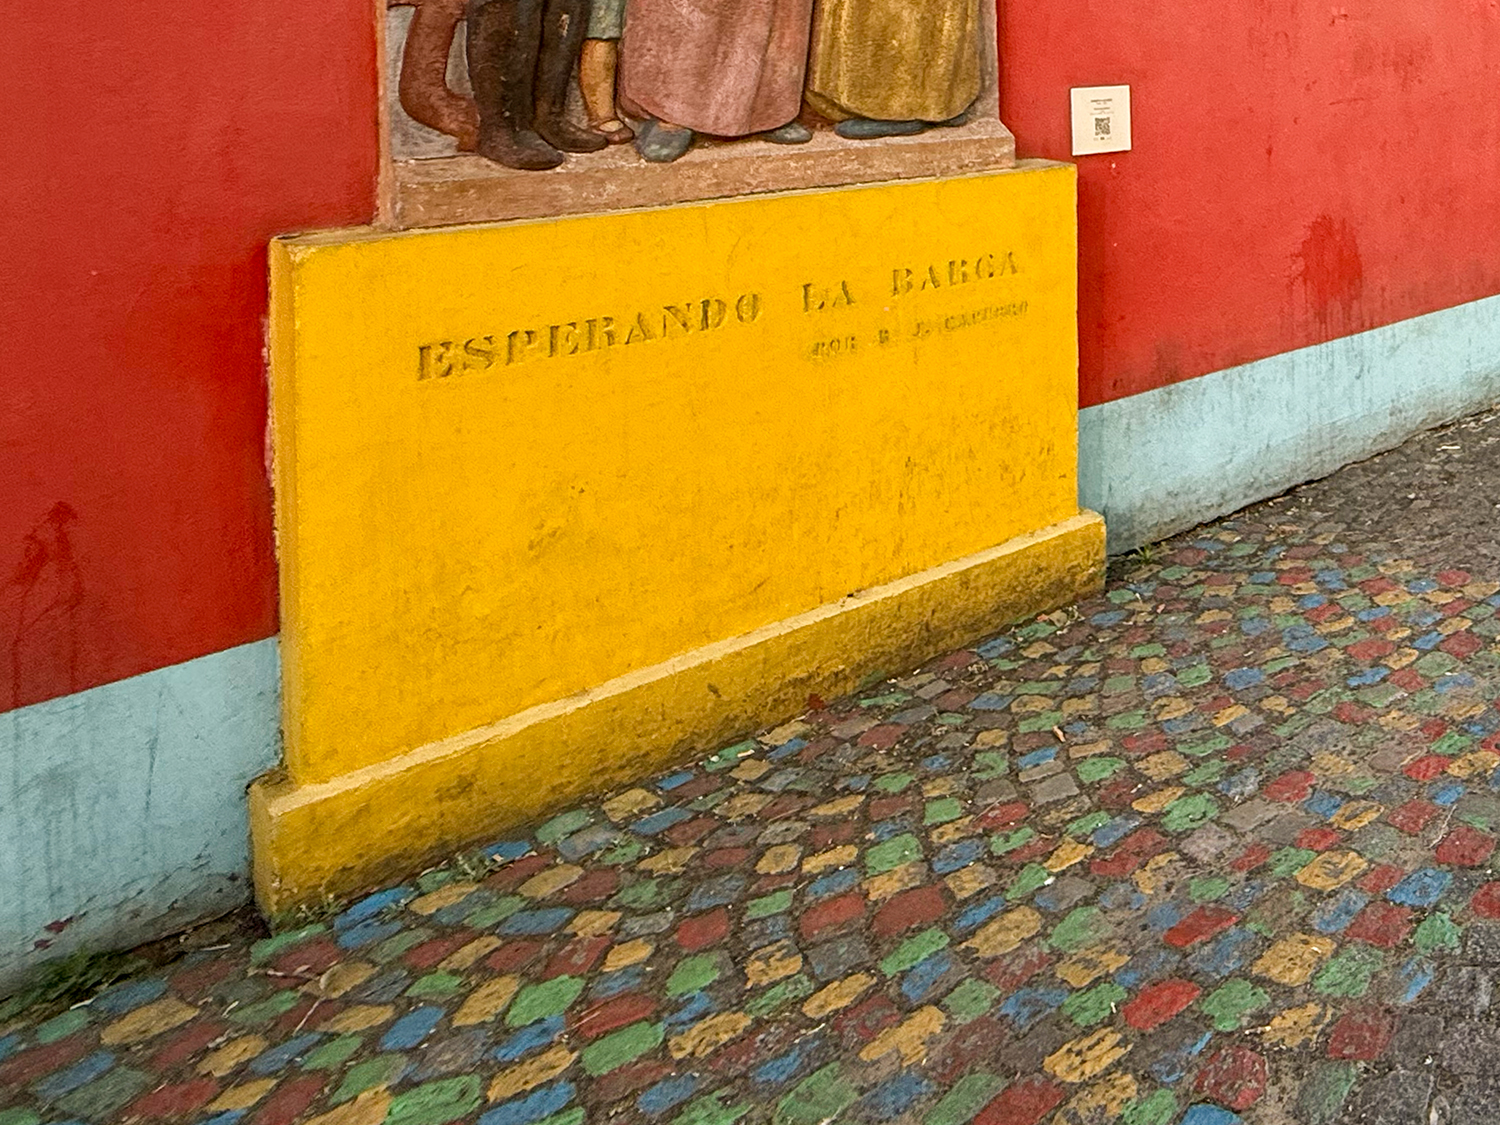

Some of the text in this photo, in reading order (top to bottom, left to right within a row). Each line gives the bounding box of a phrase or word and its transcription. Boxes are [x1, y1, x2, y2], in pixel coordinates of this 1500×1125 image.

[417, 250, 1019, 381] ESPERANDO LA BARCA
